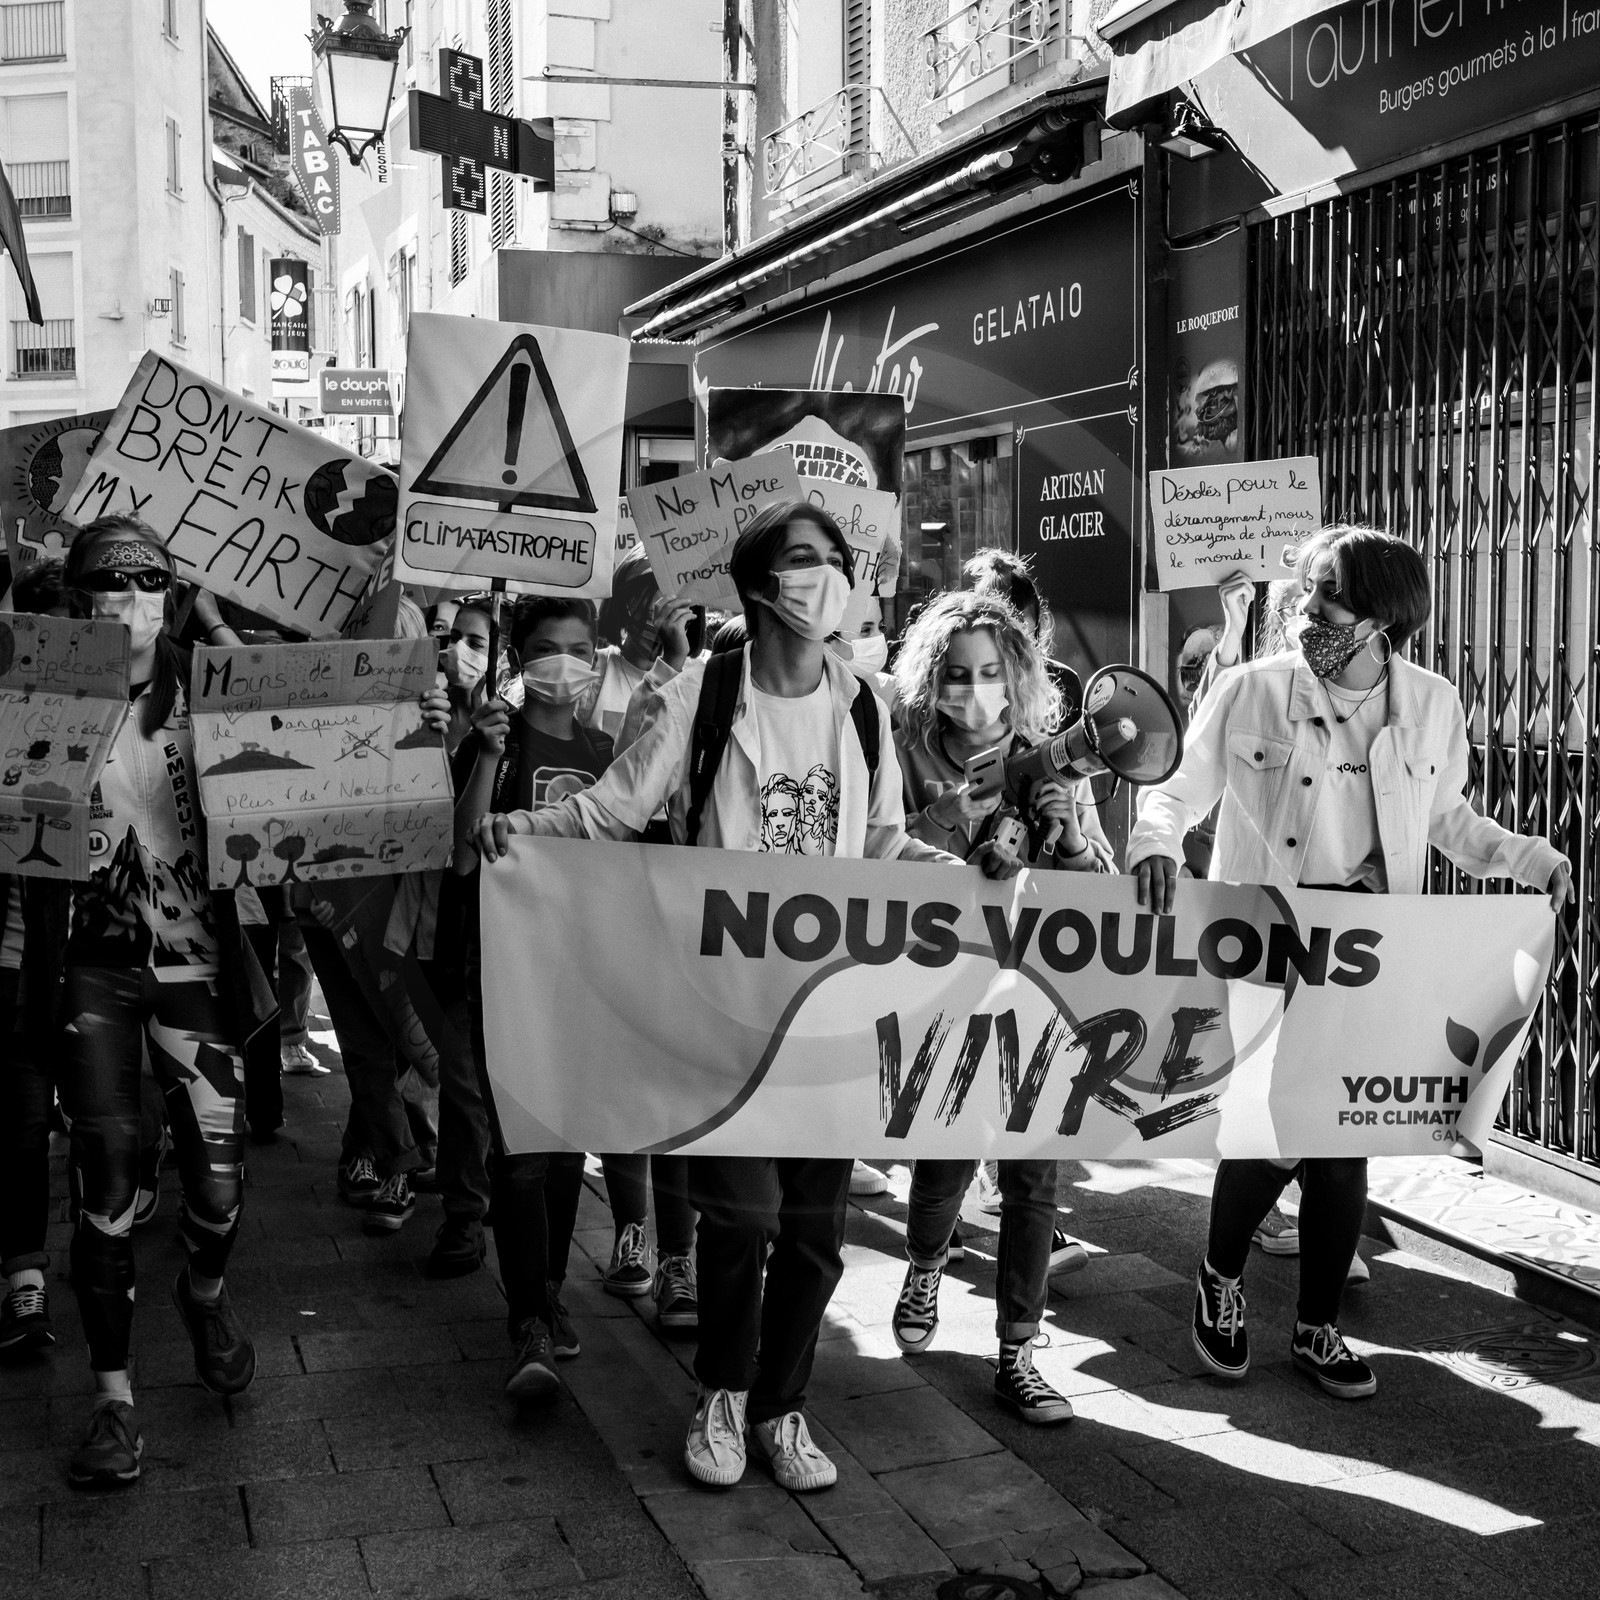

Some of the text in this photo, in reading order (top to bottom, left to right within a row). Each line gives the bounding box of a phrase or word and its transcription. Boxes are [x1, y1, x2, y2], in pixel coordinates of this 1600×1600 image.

[1379, 75, 1434, 114] Burgers
[1438, 39, 1517, 97] gourmets
[1521, 30, 1535, 57] à
[1539, 24, 1556, 51] la
[296, 109, 335, 215] TABAC
[973, 282, 1082, 346] GELATAIO
[1176, 305, 1240, 335] LE ROQUEFORT
[325, 377, 338, 391] le
[141, 357, 289, 458] DON'T
[341, 398, 353, 406] EN
[354, 398, 383, 406] VENTE
[116, 404, 301, 515] BREAK
[655, 486, 700, 521] No
[709, 472, 785, 508] More
[1039, 469, 1105, 503] ARTISAN
[1161, 469, 1308, 505] Désolés pour le
[1039, 511, 1105, 541] GLACIER
[1275, 509, 1314, 521] nous
[1165, 528, 1236, 549] essayons
[1239, 526, 1255, 541] de
[164, 489, 373, 634] EARTH
[1170, 551, 1185, 568] le
[1194, 548, 1254, 566] monde
[202, 655, 288, 698] Moins
[308, 657, 336, 681] de
[287, 688, 329, 707] plus
[211, 723, 238, 742] de
[270, 713, 362, 738] Banquise
[1336, 762, 1367, 776] YOKO
[163, 742, 196, 841] EMBRUN
[299, 789, 317, 803] de
[340, 778, 407, 800] Nature
[333, 816, 364, 836] de
[699, 888, 1385, 988] NOUS VOULONS
[875, 1006, 1223, 1142] VIVRE
[1341, 1075, 1469, 1104] YOUTH
[1338, 1110, 1377, 1126] FOR
